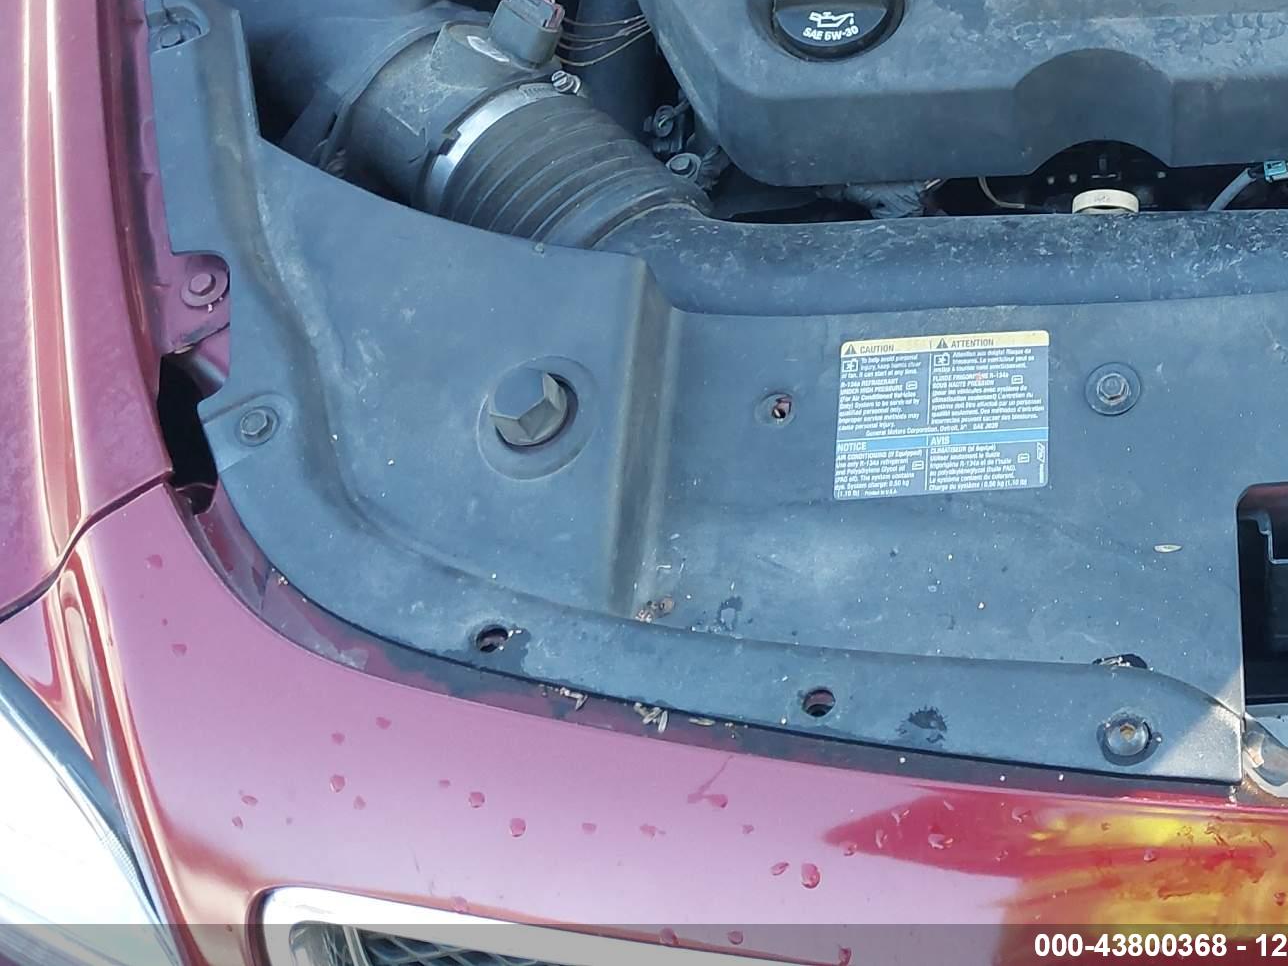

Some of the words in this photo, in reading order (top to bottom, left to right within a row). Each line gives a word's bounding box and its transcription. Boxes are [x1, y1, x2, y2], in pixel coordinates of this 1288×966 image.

[802, 27, 824, 41] SAE
[824, 25, 859, 41] 5W-30
[951, 338, 994, 348] ATTENTION
[860, 345, 894, 354] CAUTION
[931, 436, 950, 445] AVIS
[837, 442, 867, 452] NOTICE
